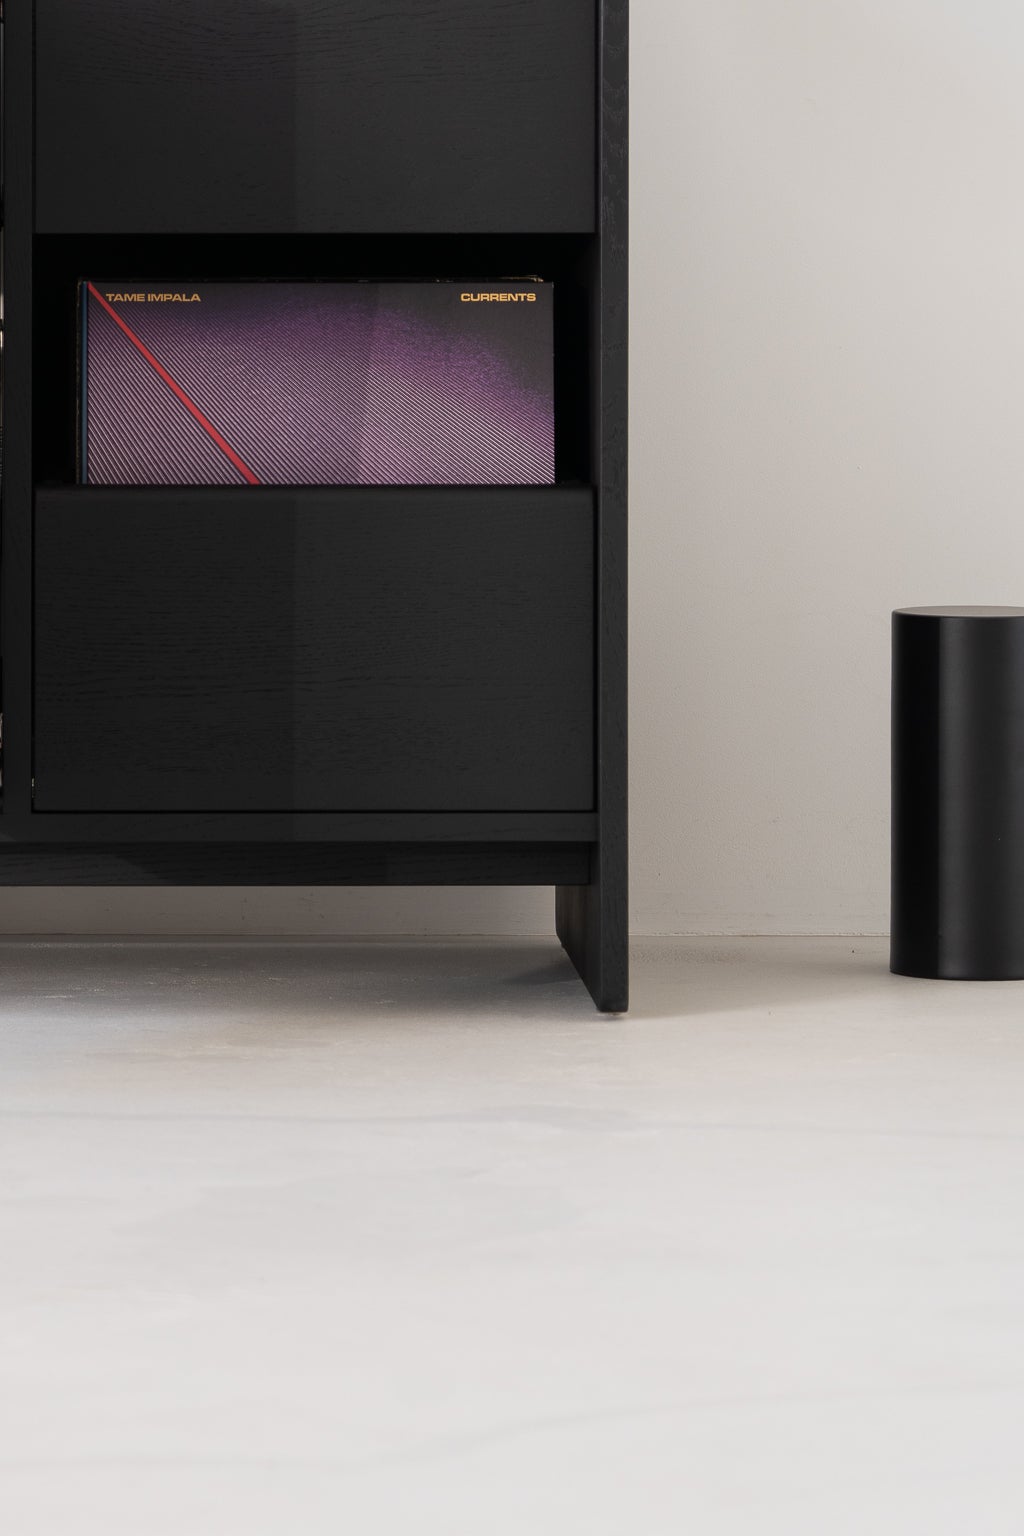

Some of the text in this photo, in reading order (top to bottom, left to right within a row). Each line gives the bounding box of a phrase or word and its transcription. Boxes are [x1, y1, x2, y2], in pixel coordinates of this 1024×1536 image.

[105, 293, 201, 302] TAME IMPALA
[460, 292, 537, 303] CURRENTS
